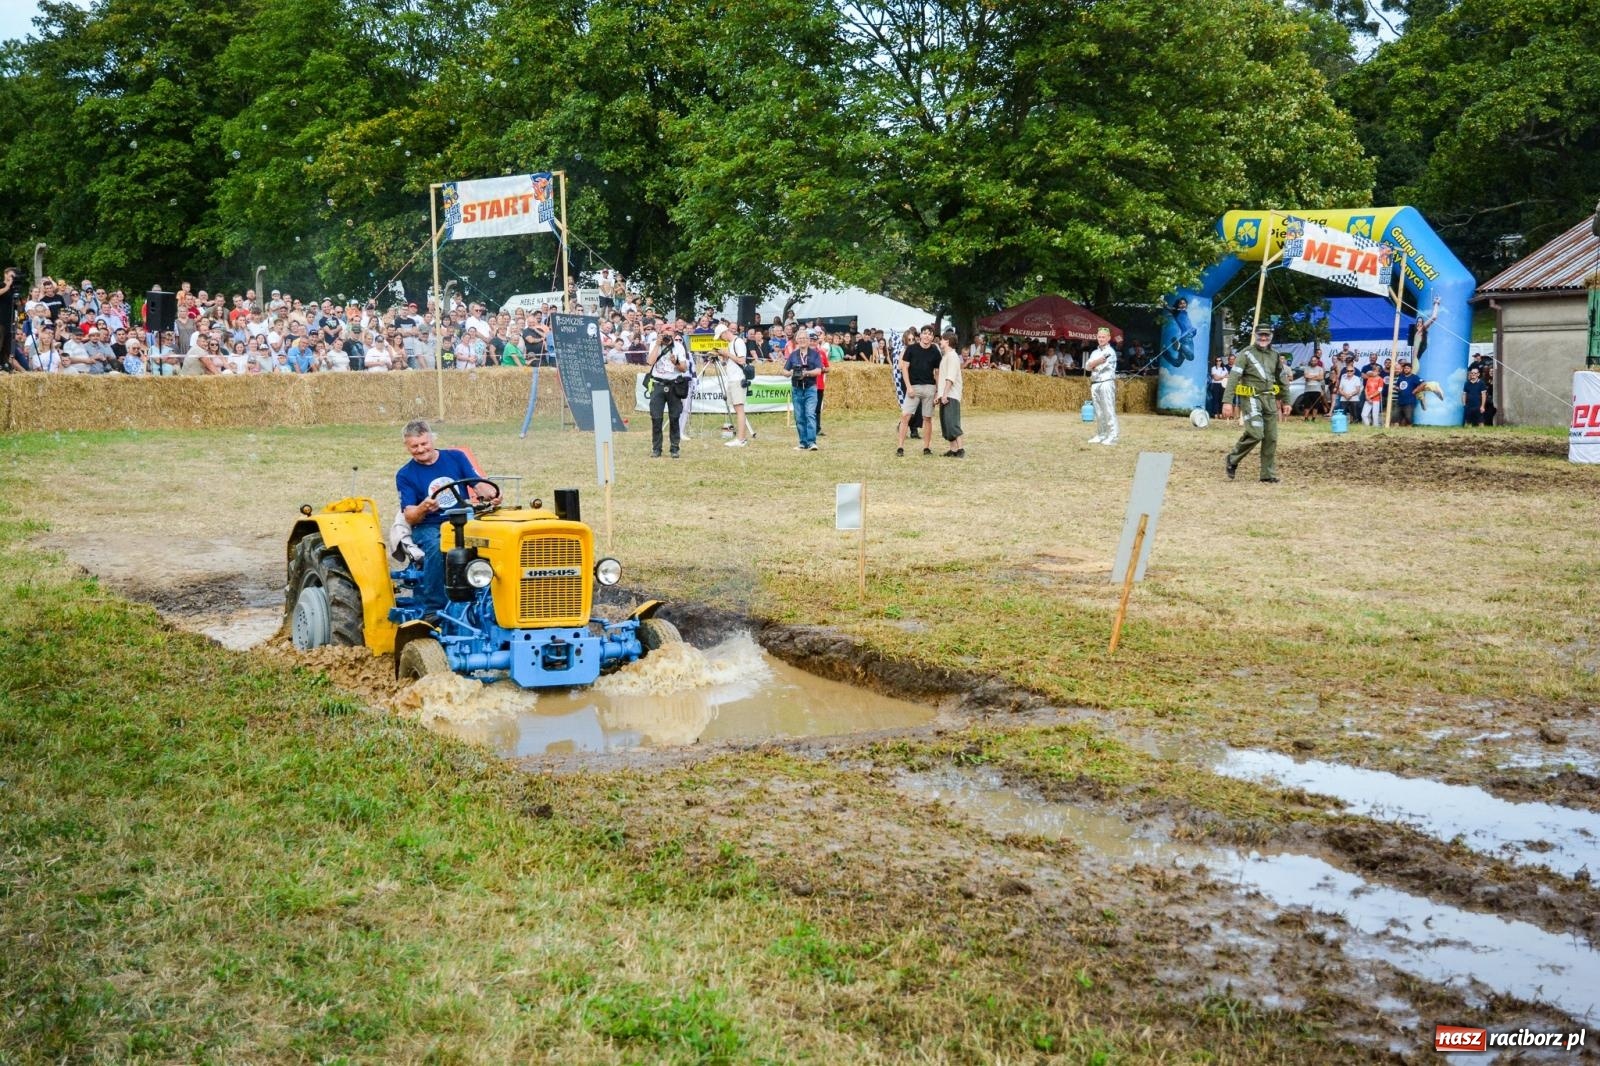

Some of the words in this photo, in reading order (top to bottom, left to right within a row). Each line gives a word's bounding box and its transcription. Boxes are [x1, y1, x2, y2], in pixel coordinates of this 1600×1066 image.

[462, 193, 534, 224] START
[1302, 238, 1378, 276] META
[1391, 226, 1417, 257] Gmina
[1009, 327, 1056, 337] RACIBORSKIE
[527, 569, 577, 577] URSUS
